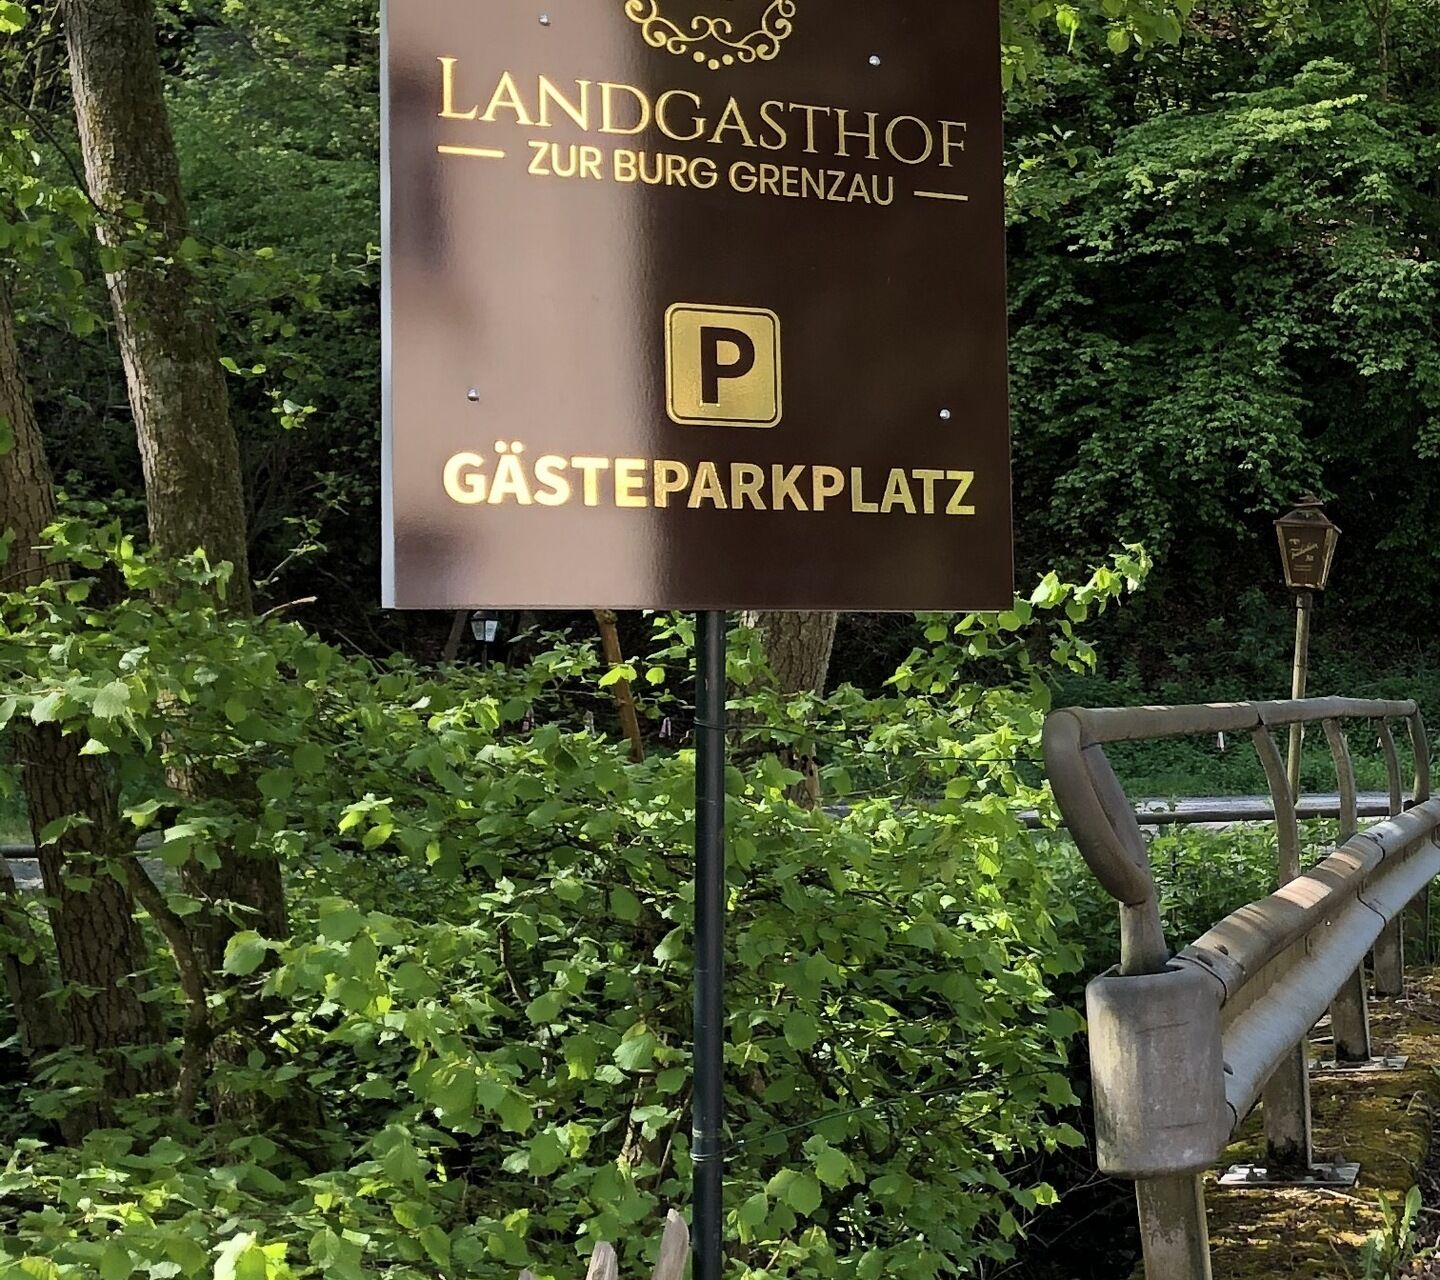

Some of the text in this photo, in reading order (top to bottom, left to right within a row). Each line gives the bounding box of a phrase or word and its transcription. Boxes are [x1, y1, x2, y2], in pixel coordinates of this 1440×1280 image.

[437, 57, 967, 167] LANDGASTHOF
[528, 141, 894, 205] ZUR BURG GRENZAU
[699, 326, 755, 404] P
[443, 442, 975, 515] GÄSTEPARKPLATZ
